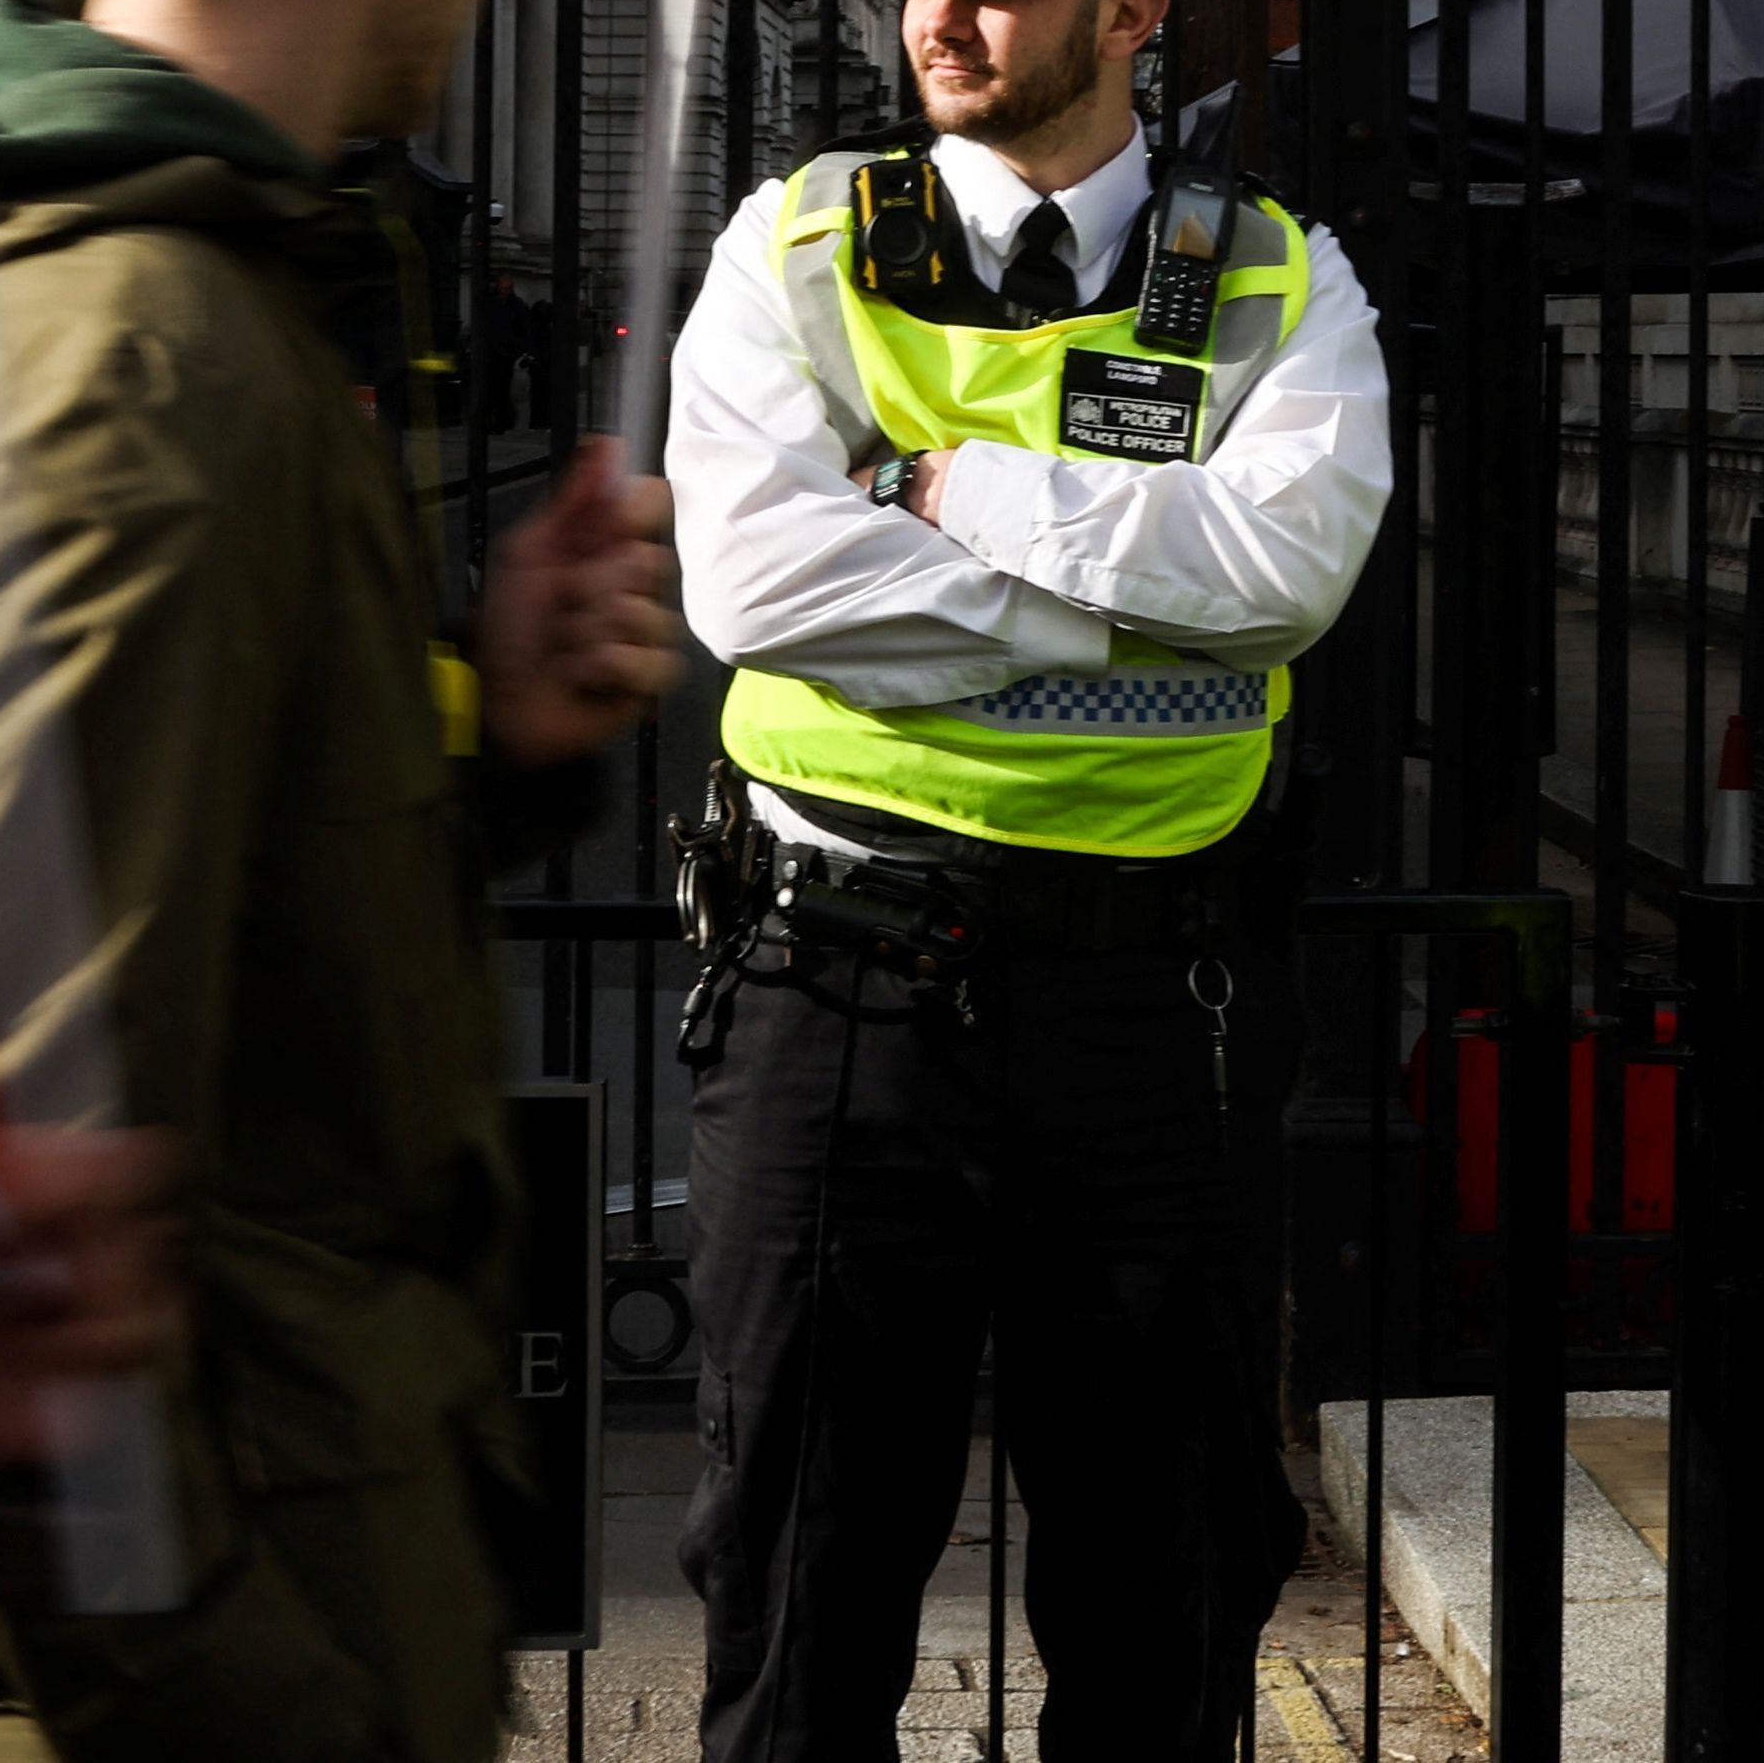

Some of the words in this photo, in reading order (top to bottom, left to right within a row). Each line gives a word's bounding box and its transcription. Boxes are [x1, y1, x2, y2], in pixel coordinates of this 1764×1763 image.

[1108, 401, 1183, 417] METROPOLITAN
[1118, 412, 1172, 430] POLICE
[1066, 425, 1120, 447] POLICE
[1122, 434, 1186, 453] OFFICER
